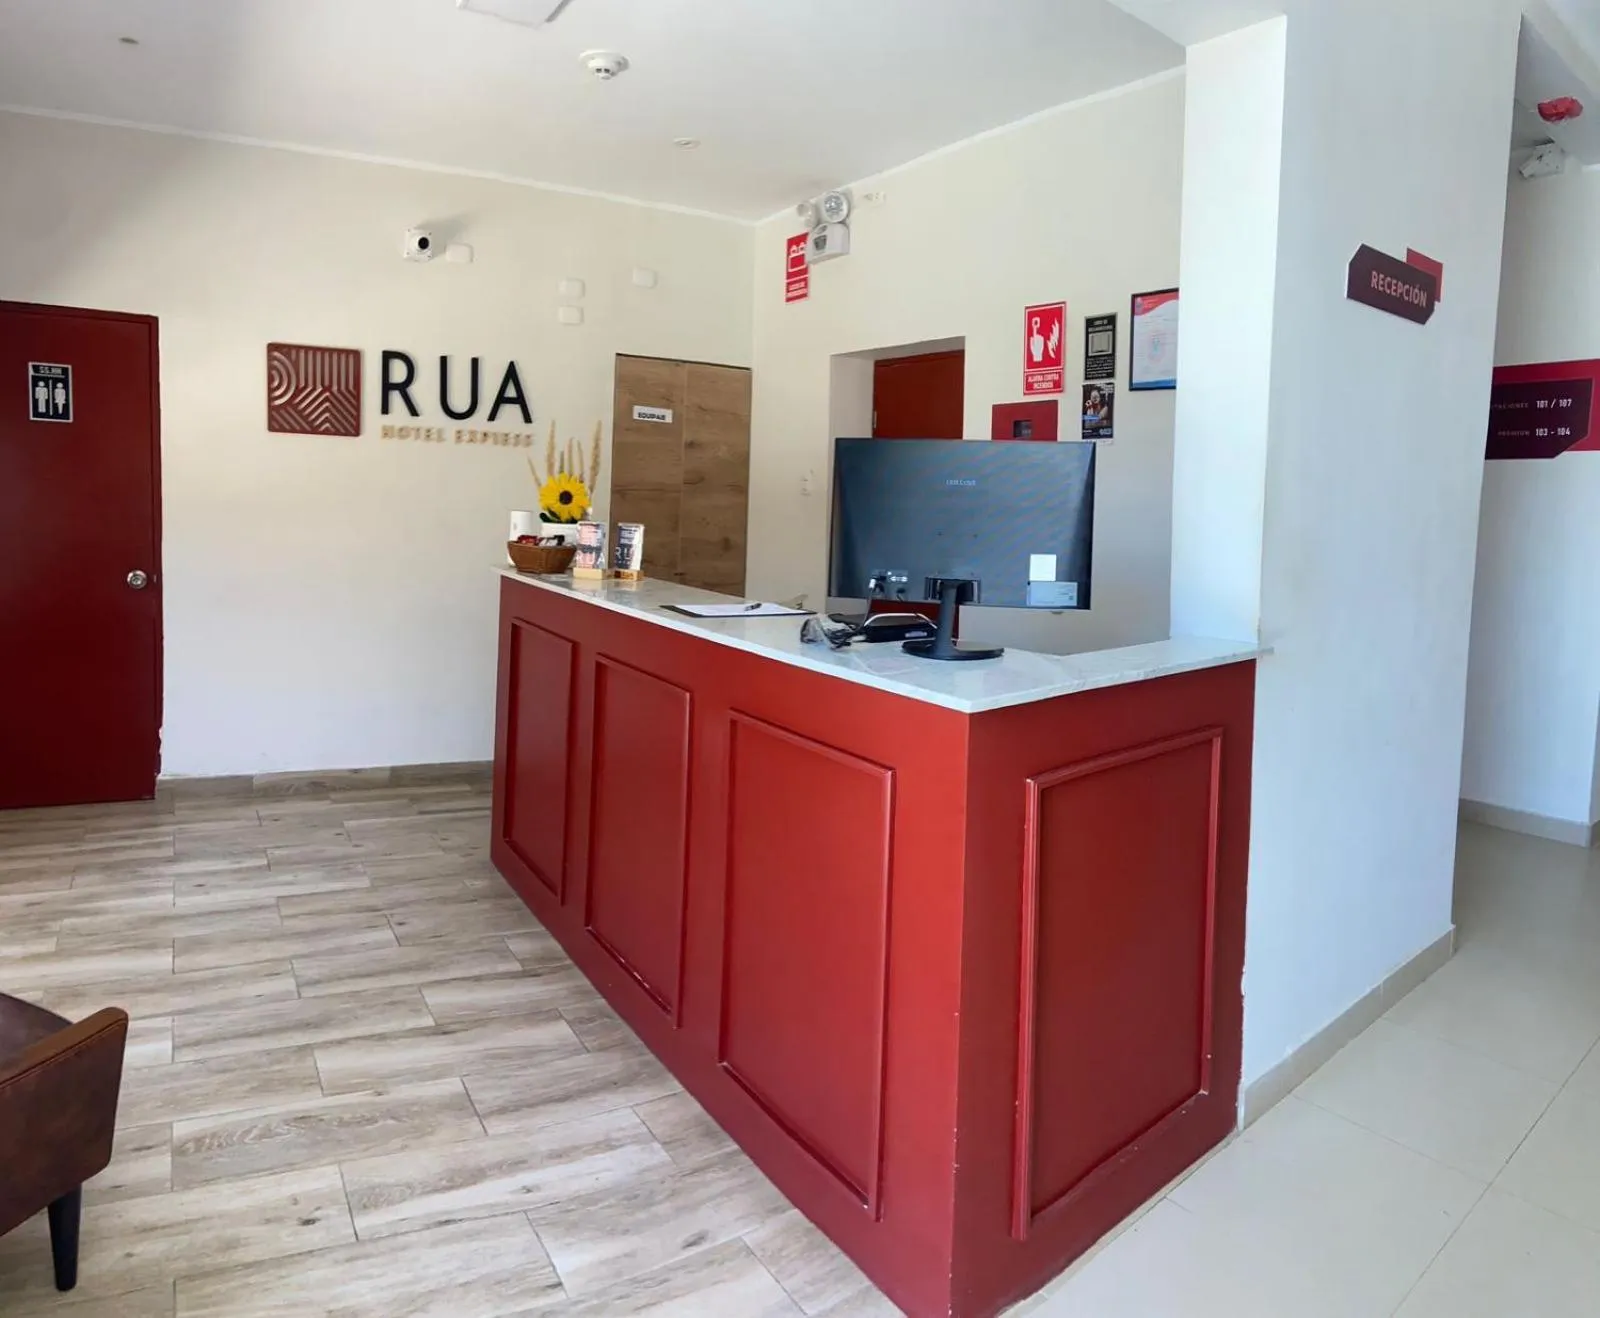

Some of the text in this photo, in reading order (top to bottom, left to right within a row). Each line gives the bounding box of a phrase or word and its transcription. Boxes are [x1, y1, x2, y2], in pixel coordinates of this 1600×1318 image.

[1370, 270, 1428, 308] RECEPCIÓN
[381, 350, 533, 424] RUA
[1536, 400, 1548, 409] 101
[1559, 399, 1572, 408] 107
[381, 425, 533, 447] HOTEL EXPRESS
[1557, 427, 1571, 436] 104
